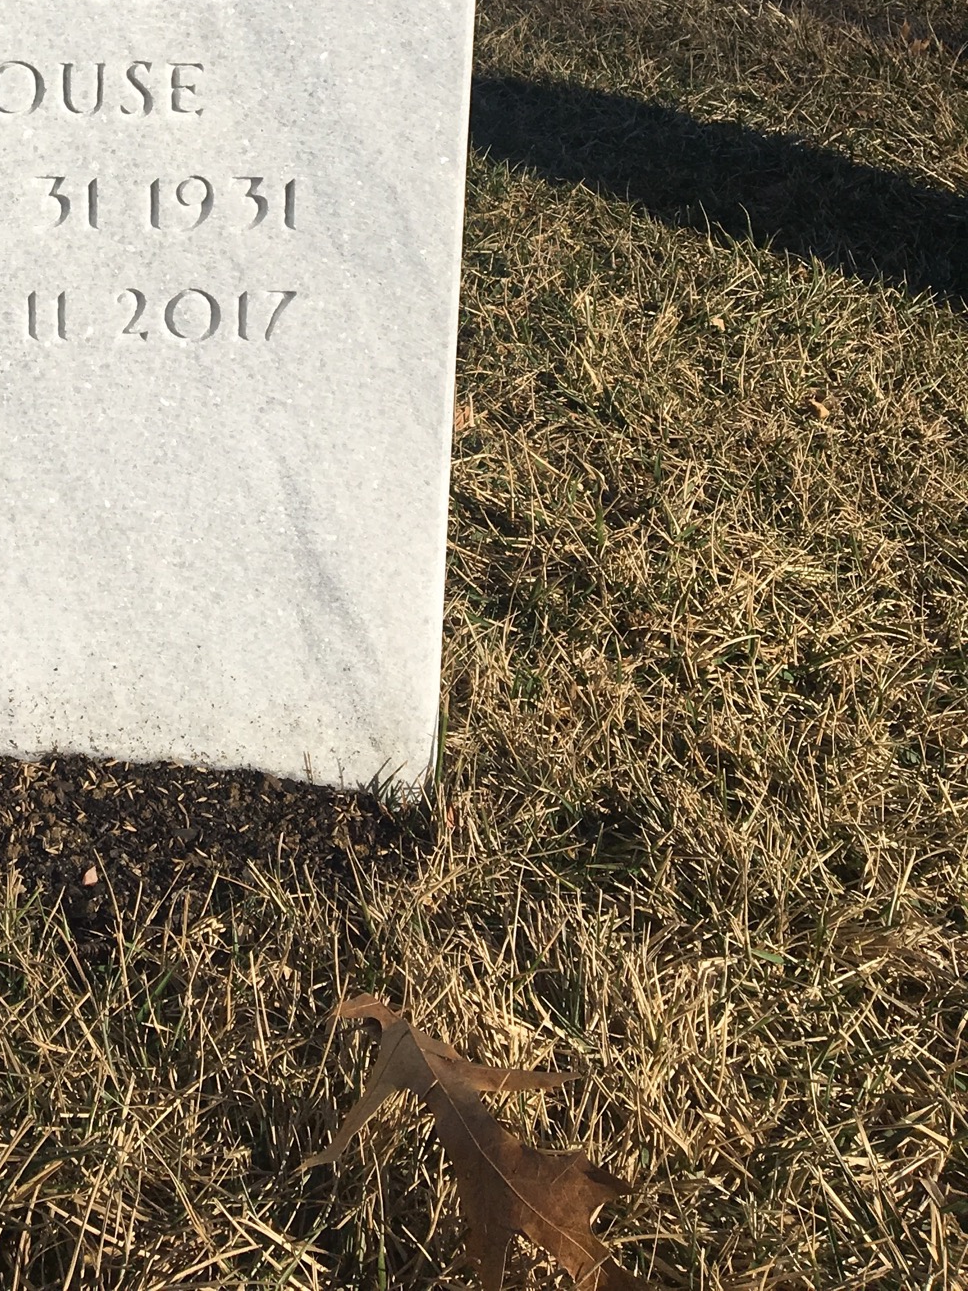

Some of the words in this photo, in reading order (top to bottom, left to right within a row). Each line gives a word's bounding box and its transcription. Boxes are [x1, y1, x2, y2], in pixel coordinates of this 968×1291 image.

[34, 174, 100, 231] 31
[149, 174, 297, 232] 1931
[25, 288, 69, 342] 11
[115, 287, 298, 343] 2017
